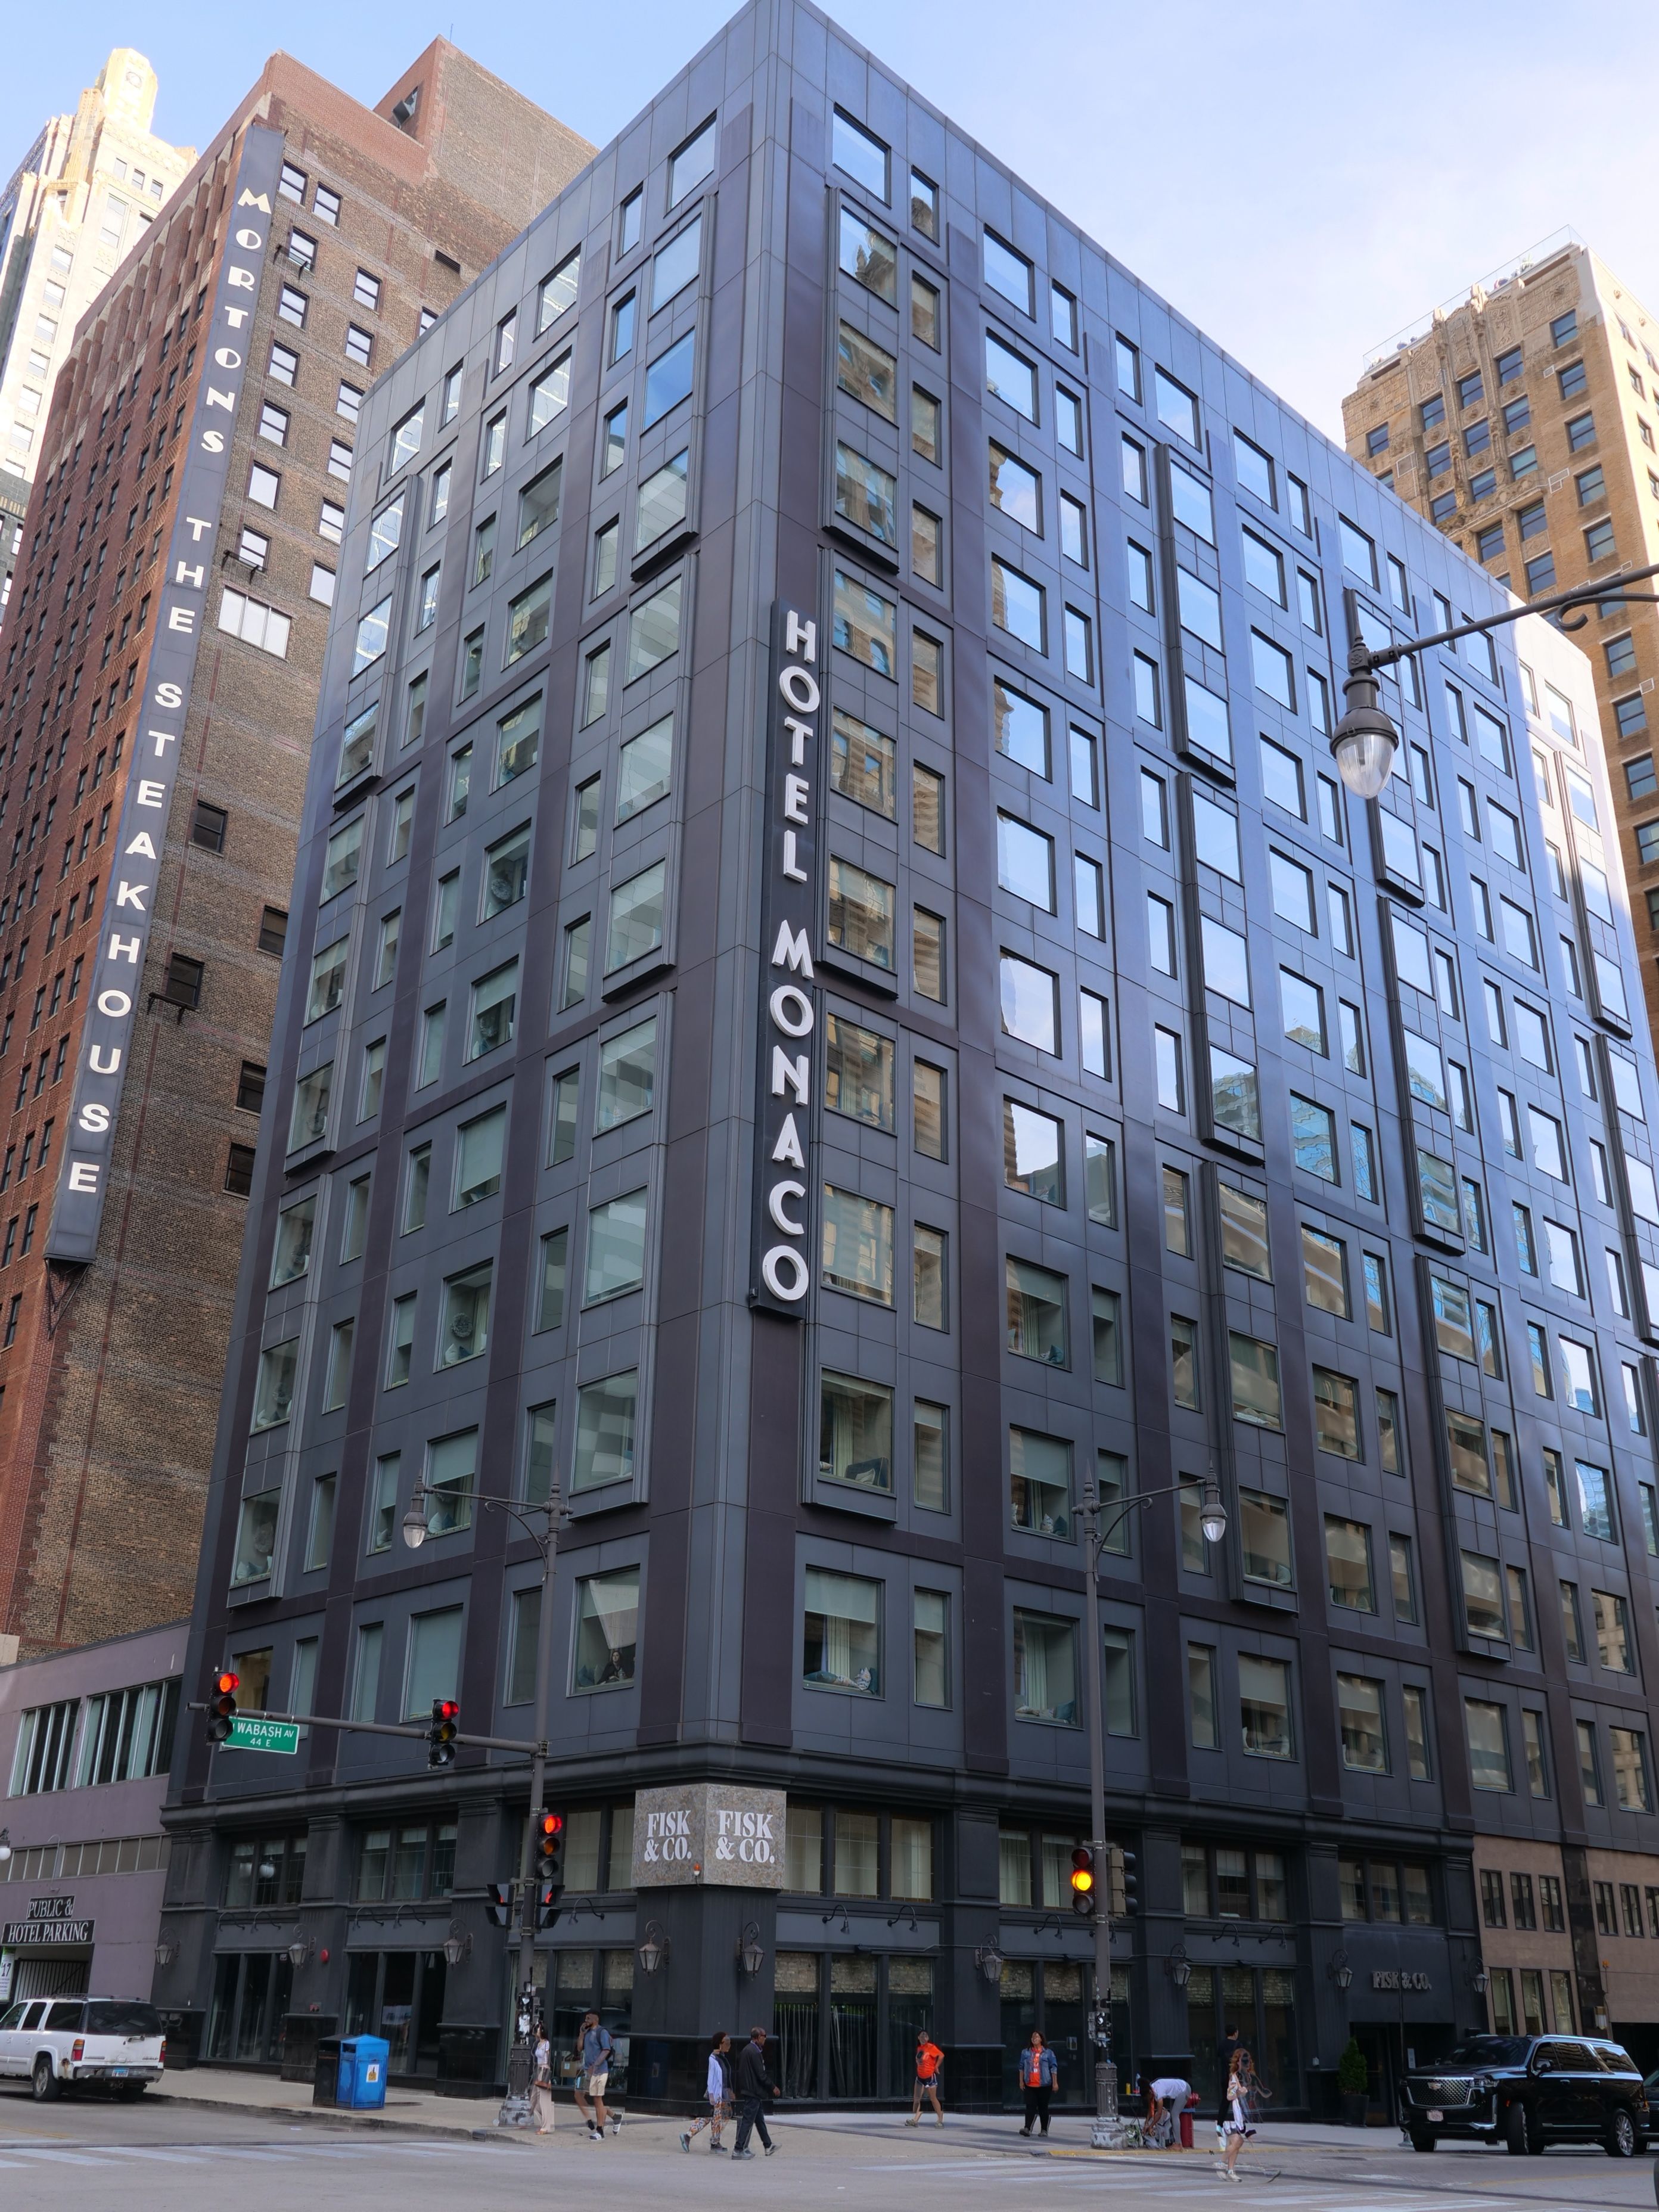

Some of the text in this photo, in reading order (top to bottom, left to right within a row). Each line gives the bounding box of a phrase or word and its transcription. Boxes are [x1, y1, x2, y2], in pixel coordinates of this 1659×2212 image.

[68, 188, 271, 1192] MORTONS THE STEAKHOUSE
[762, 609, 820, 1301] HOTEL MONACO
[237, 1722, 281, 1738] WABASH
[647, 1810, 691, 1837] FISK
[719, 1810, 773, 1839] FISK
[644, 1837, 692, 1862] & CO.
[716, 1837, 775, 1863] & CO.
[27, 1899, 73, 1918] PUBLIC &
[7, 1922, 89, 1943] HOTEL PARKING
[1372, 1971, 1432, 1990] FISK & CO.
